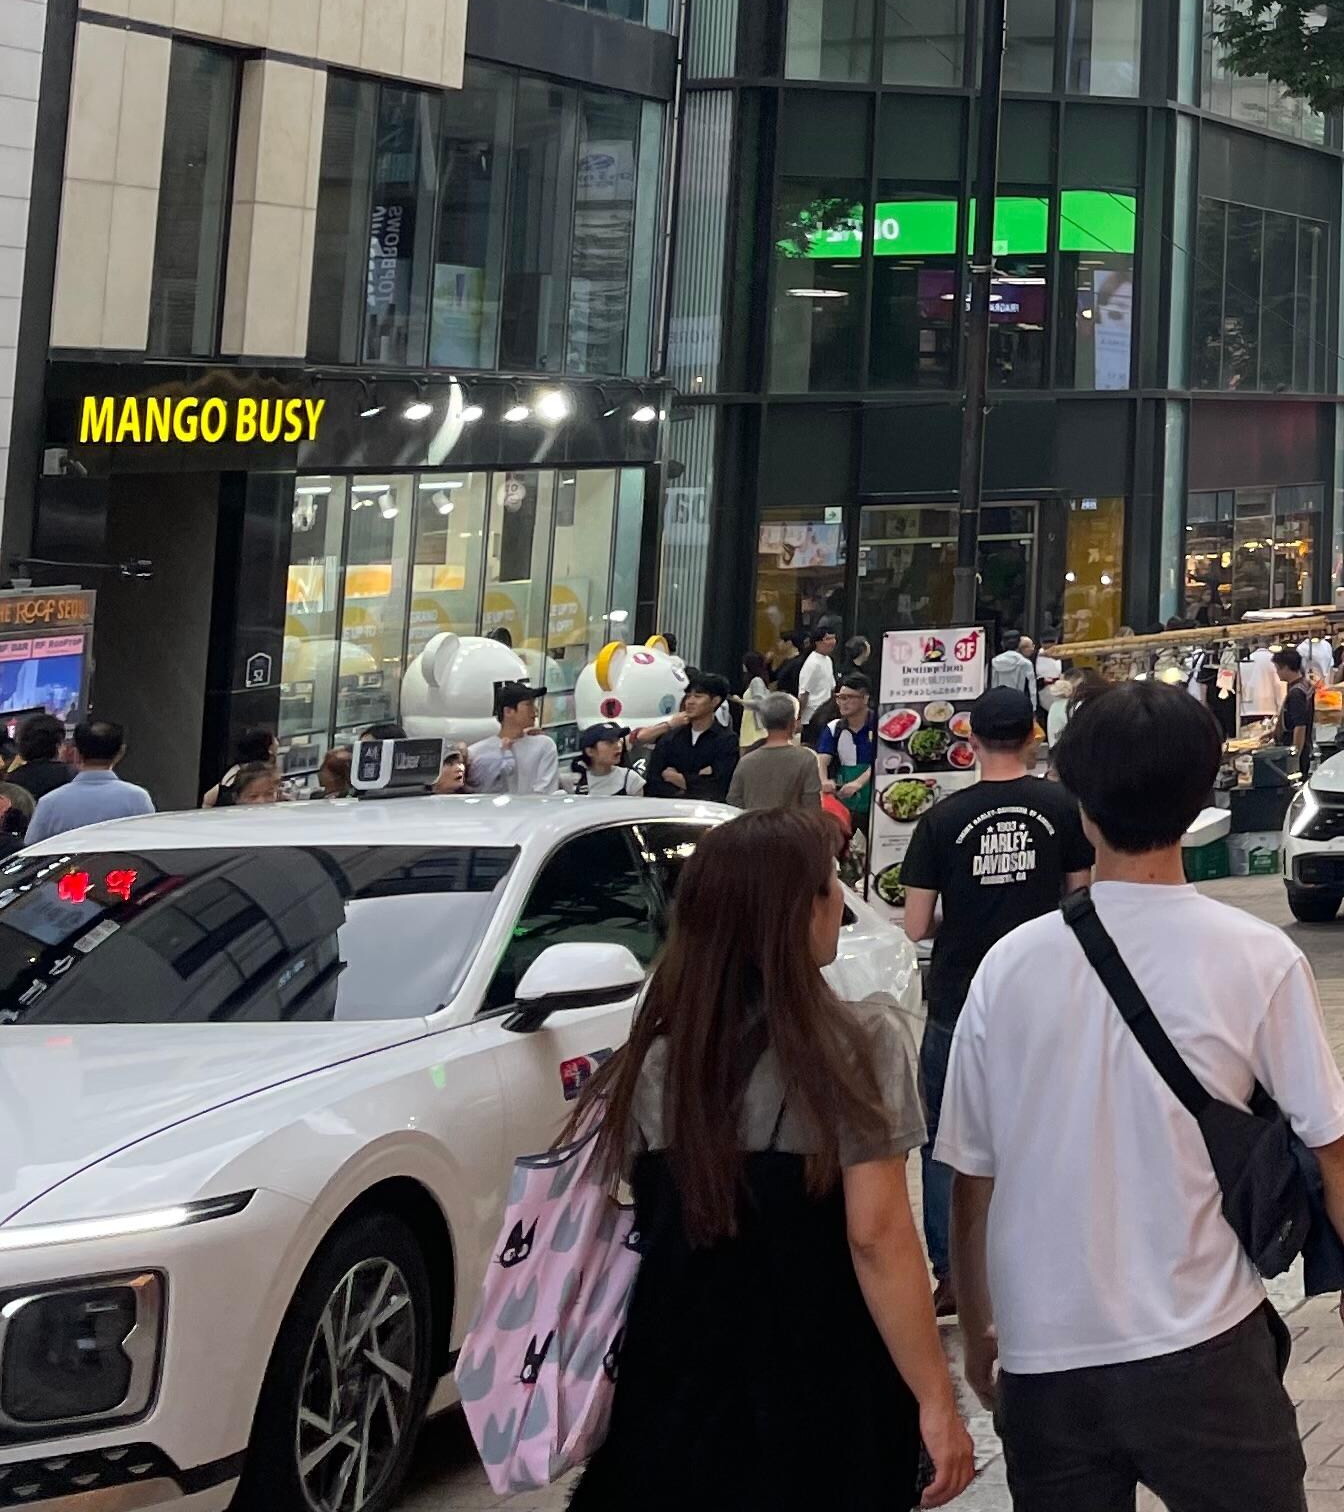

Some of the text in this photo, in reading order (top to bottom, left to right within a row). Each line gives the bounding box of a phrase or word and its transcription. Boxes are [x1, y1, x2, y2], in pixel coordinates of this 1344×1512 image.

[80, 396, 326, 443] MANGO BUSY
[15, 599, 55, 624] ROOF
[957, 642, 975, 659] 3F
[253, 669, 264, 682] 52
[980, 831, 1033, 855] HARLEY-
[973, 849, 1036, 876] DAVIDSON
